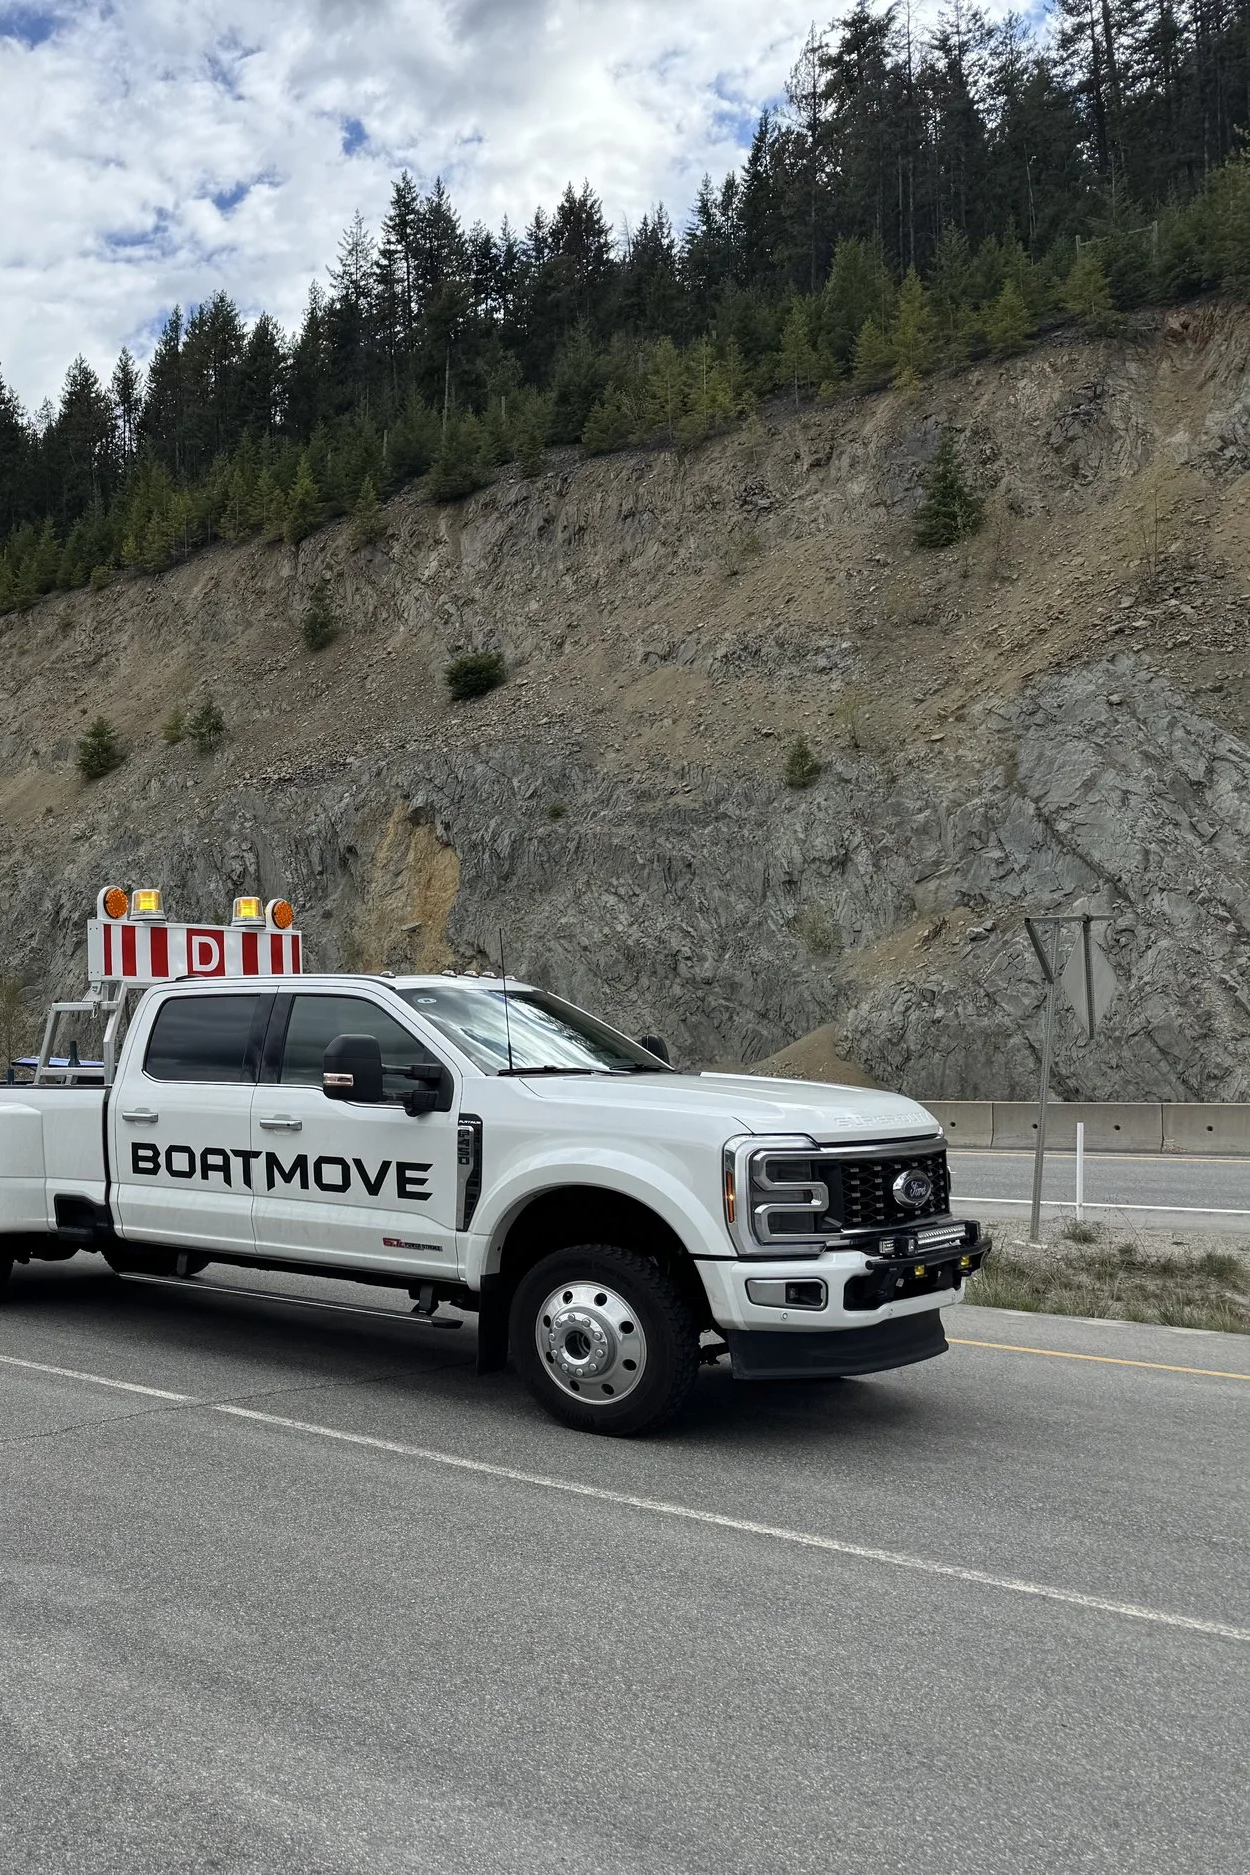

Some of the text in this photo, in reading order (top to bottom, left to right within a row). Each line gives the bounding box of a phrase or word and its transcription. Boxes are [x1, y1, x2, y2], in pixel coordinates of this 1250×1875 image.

[191, 935, 220, 972] D
[131, 1141, 435, 1202] BOATMOVE
[910, 1180, 927, 1198] Ford
